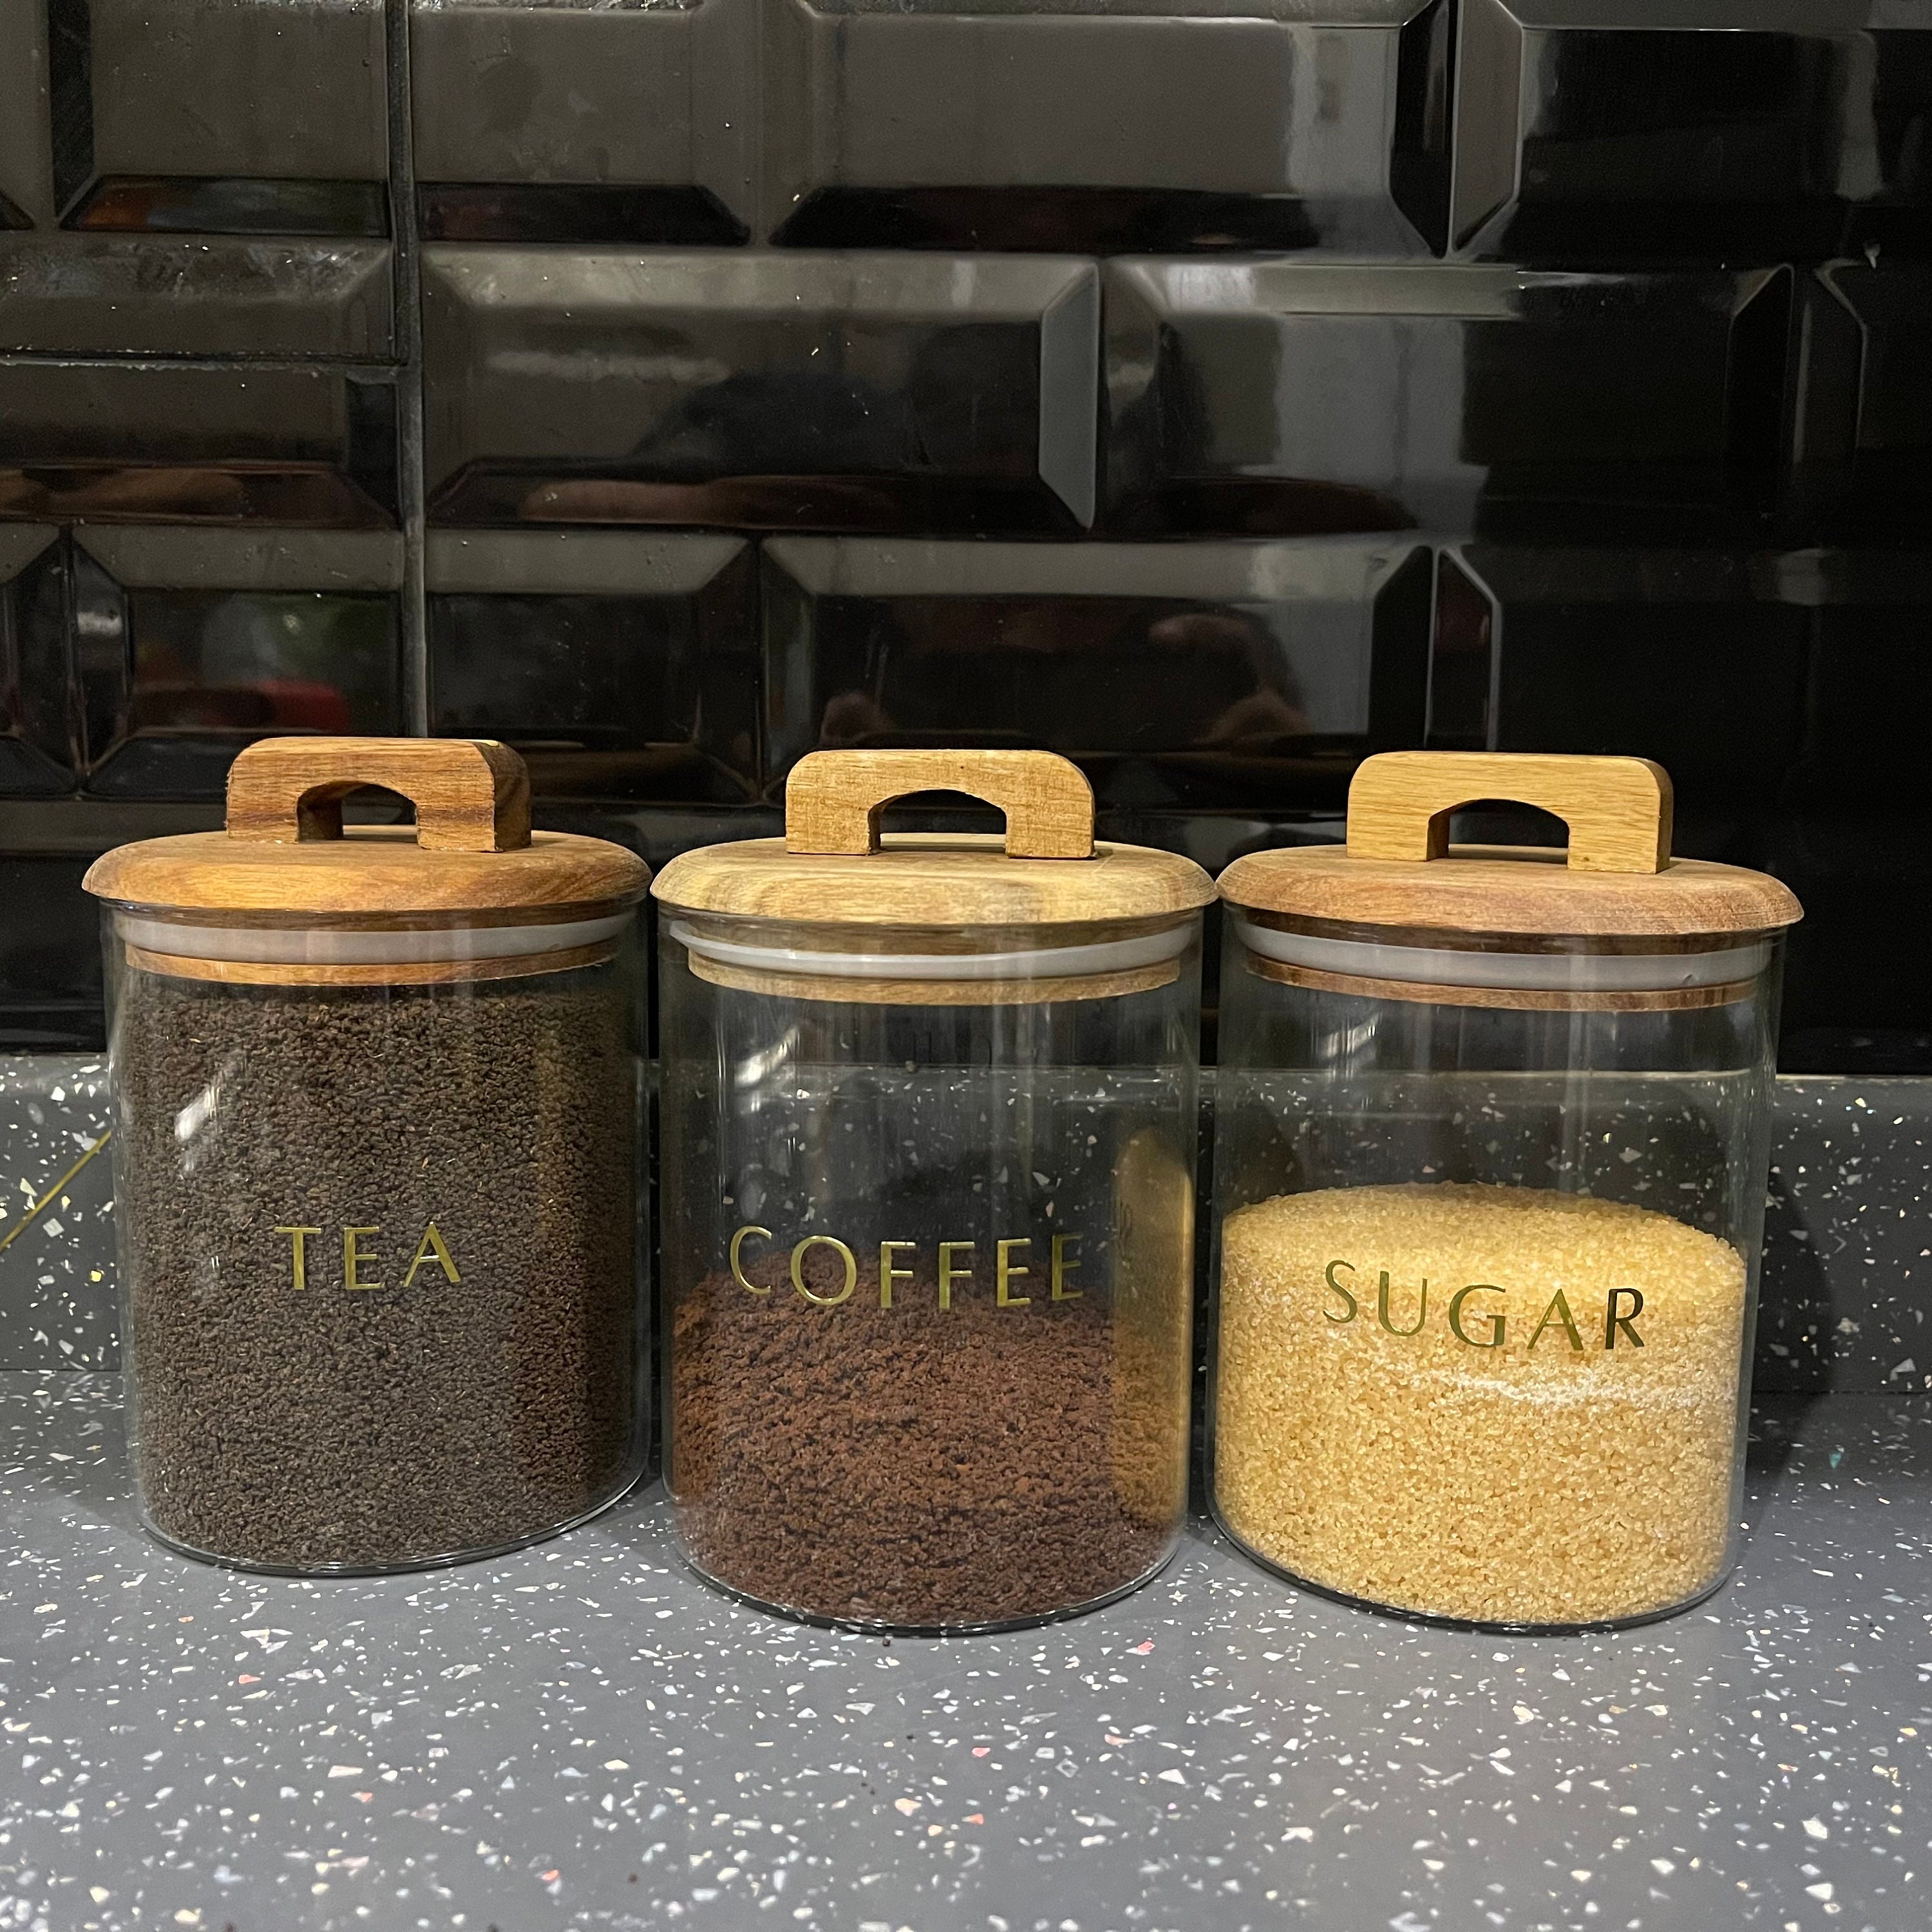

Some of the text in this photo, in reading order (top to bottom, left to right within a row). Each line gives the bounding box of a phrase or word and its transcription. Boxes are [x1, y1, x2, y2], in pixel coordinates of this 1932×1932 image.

[274, 1221, 461, 1290] TEA
[730, 1226, 1083, 1309] COFFEE
[1323, 1260, 1645, 1350] SUGAR
